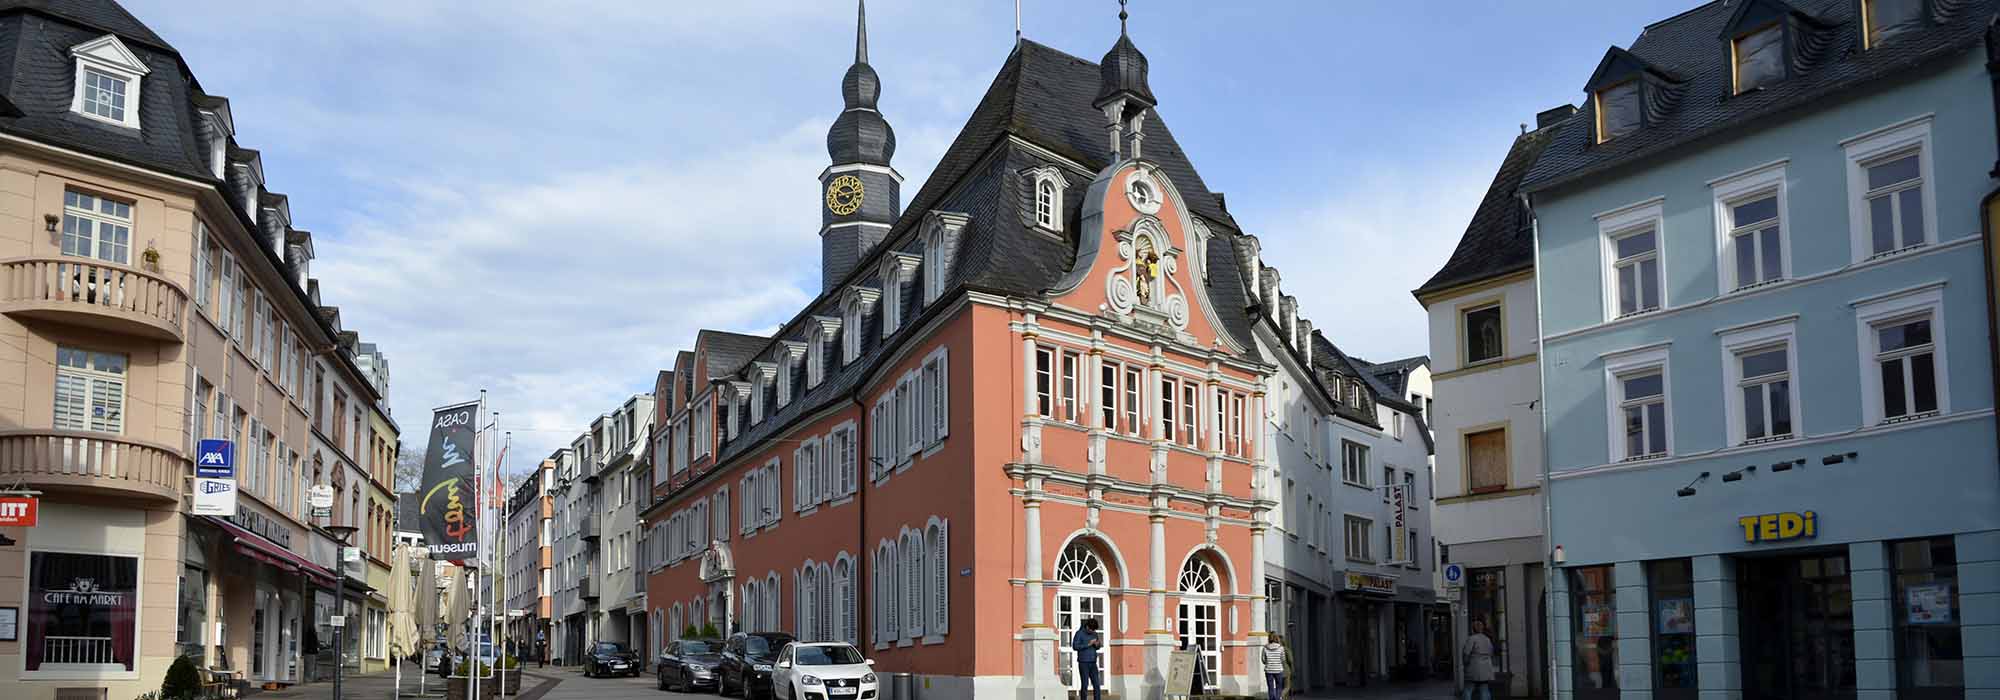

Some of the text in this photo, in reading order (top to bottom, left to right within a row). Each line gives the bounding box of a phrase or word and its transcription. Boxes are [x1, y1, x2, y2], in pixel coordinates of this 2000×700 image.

[199, 452, 224, 464] AXA
[206, 480, 231, 494] GRIES
[0, 503, 28, 517] ITT
[1394, 486, 1403, 528] PALAST
[1738, 510, 1817, 542] TEDi
[89, 595, 122, 605] MARKT
